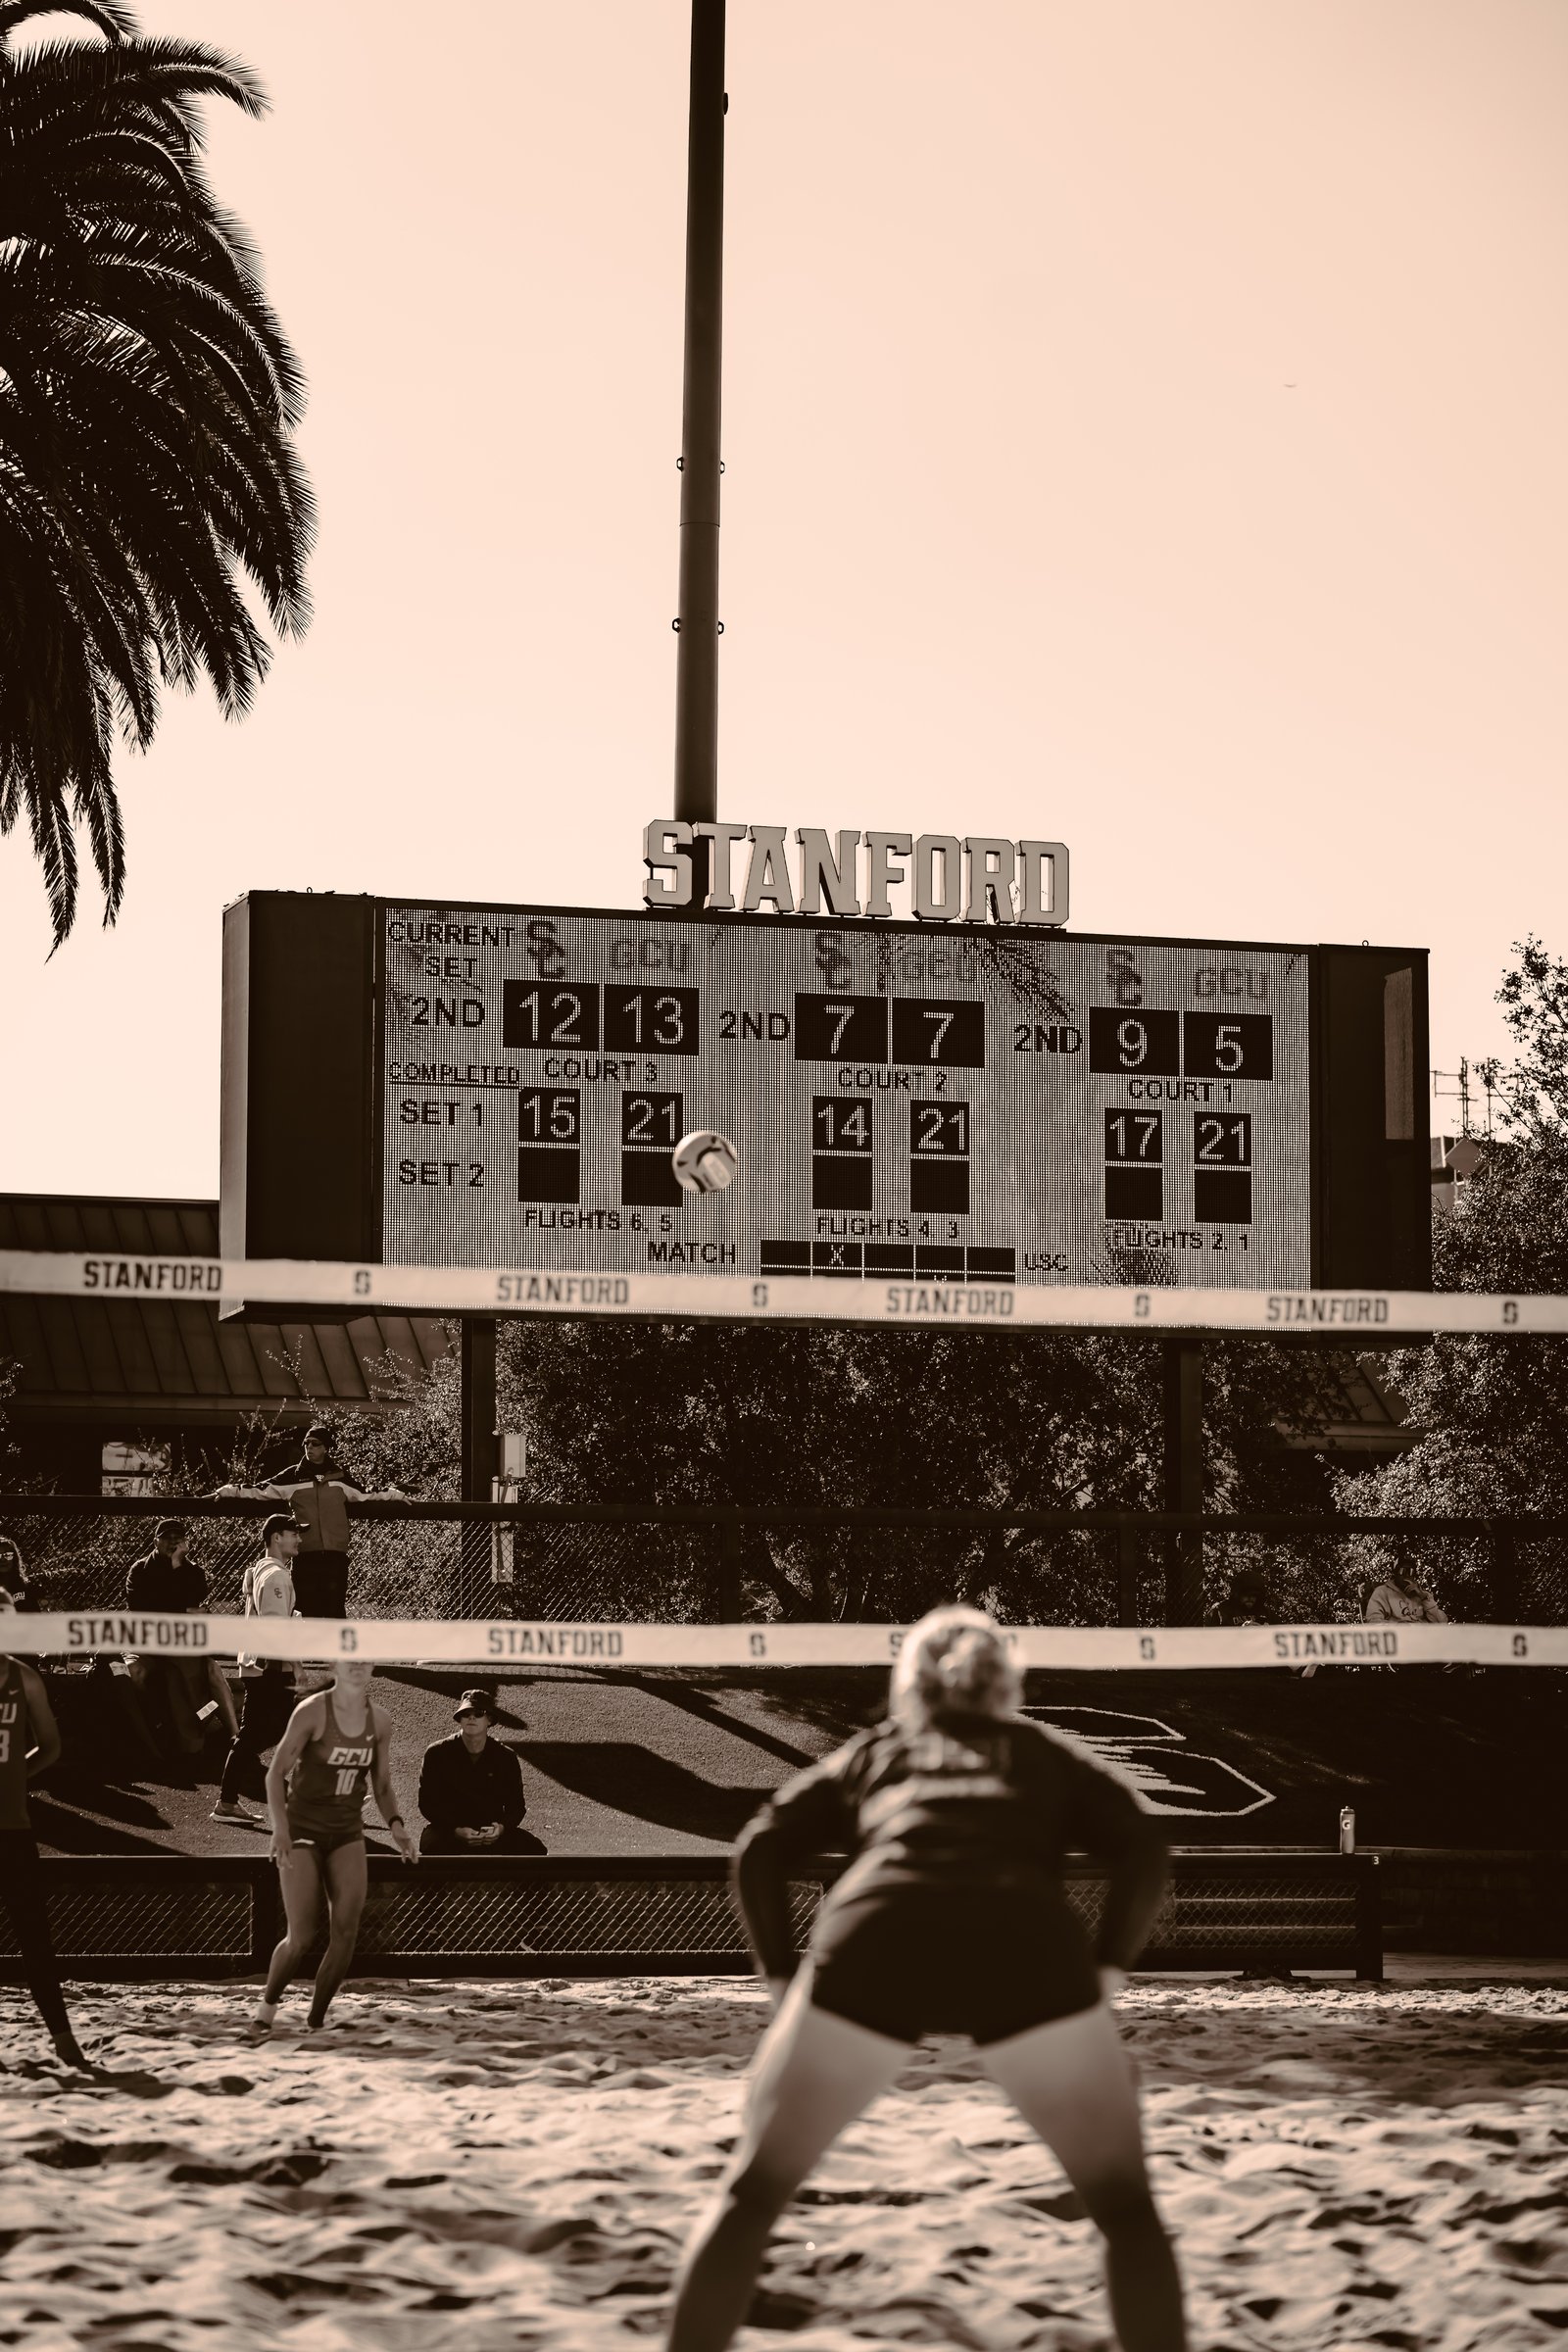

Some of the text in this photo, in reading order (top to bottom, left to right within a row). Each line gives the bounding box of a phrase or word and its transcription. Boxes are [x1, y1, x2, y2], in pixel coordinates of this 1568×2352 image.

[643, 819, 1069, 925] STANFORD
[388, 921, 514, 948] CURRENT
[425, 956, 477, 979] SET
[609, 939, 689, 970] GCU
[1194, 967, 1268, 999] GCU
[412, 996, 485, 1027] 2ND
[518, 991, 581, 1043] 12
[622, 993, 684, 1045] 13
[718, 1010, 791, 1041] 2ND
[823, 1004, 855, 1054] 7
[923, 1011, 955, 1058] 7
[1013, 1024, 1083, 1054] 2ND
[1116, 1018, 1148, 1067] 9
[1215, 1025, 1244, 1072] 5
[389, 1061, 519, 1084] COMPLETED
[545, 1057, 657, 1083] COURT 3
[936, 1070, 947, 1091] 2
[1128, 1079, 1233, 1102] COURT 1
[400, 1099, 482, 1127] SET 1
[524, 1095, 576, 1138] 15
[627, 1099, 676, 1142] 21
[817, 1103, 869, 1146] 14
[918, 1108, 965, 1151] 21
[1109, 1116, 1157, 1156] 17
[1200, 1119, 1245, 1161] 21
[399, 1159, 484, 1187] SET 2
[524, 1210, 620, 1230] FLIGHTS
[661, 1214, 672, 1232] 5
[817, 1217, 909, 1237] FLIGHTS
[949, 1221, 958, 1239] 3
[647, 1242, 736, 1264] MATCH
[1114, 1229, 1203, 1250] FLIGHTS
[1238, 1234, 1249, 1250] 1
[829, 1245, 845, 1267] X
[1024, 1252, 1068, 1272] USC
[83, 1260, 222, 1293] STANFORD
[496, 1276, 629, 1304] STANFORD
[886, 1287, 1013, 1316] STANFORD
[1267, 1297, 1389, 1323] STANFORD
[68, 1619, 208, 1647] STANFORD
[489, 1628, 622, 1656] STANFORD
[1275, 1631, 1397, 1657] STANFORD
[327, 1747, 373, 1767] GCU
[334, 1769, 359, 1795] 10
[1343, 1820, 1351, 1830] G
[1373, 1855, 1380, 1865] 3
